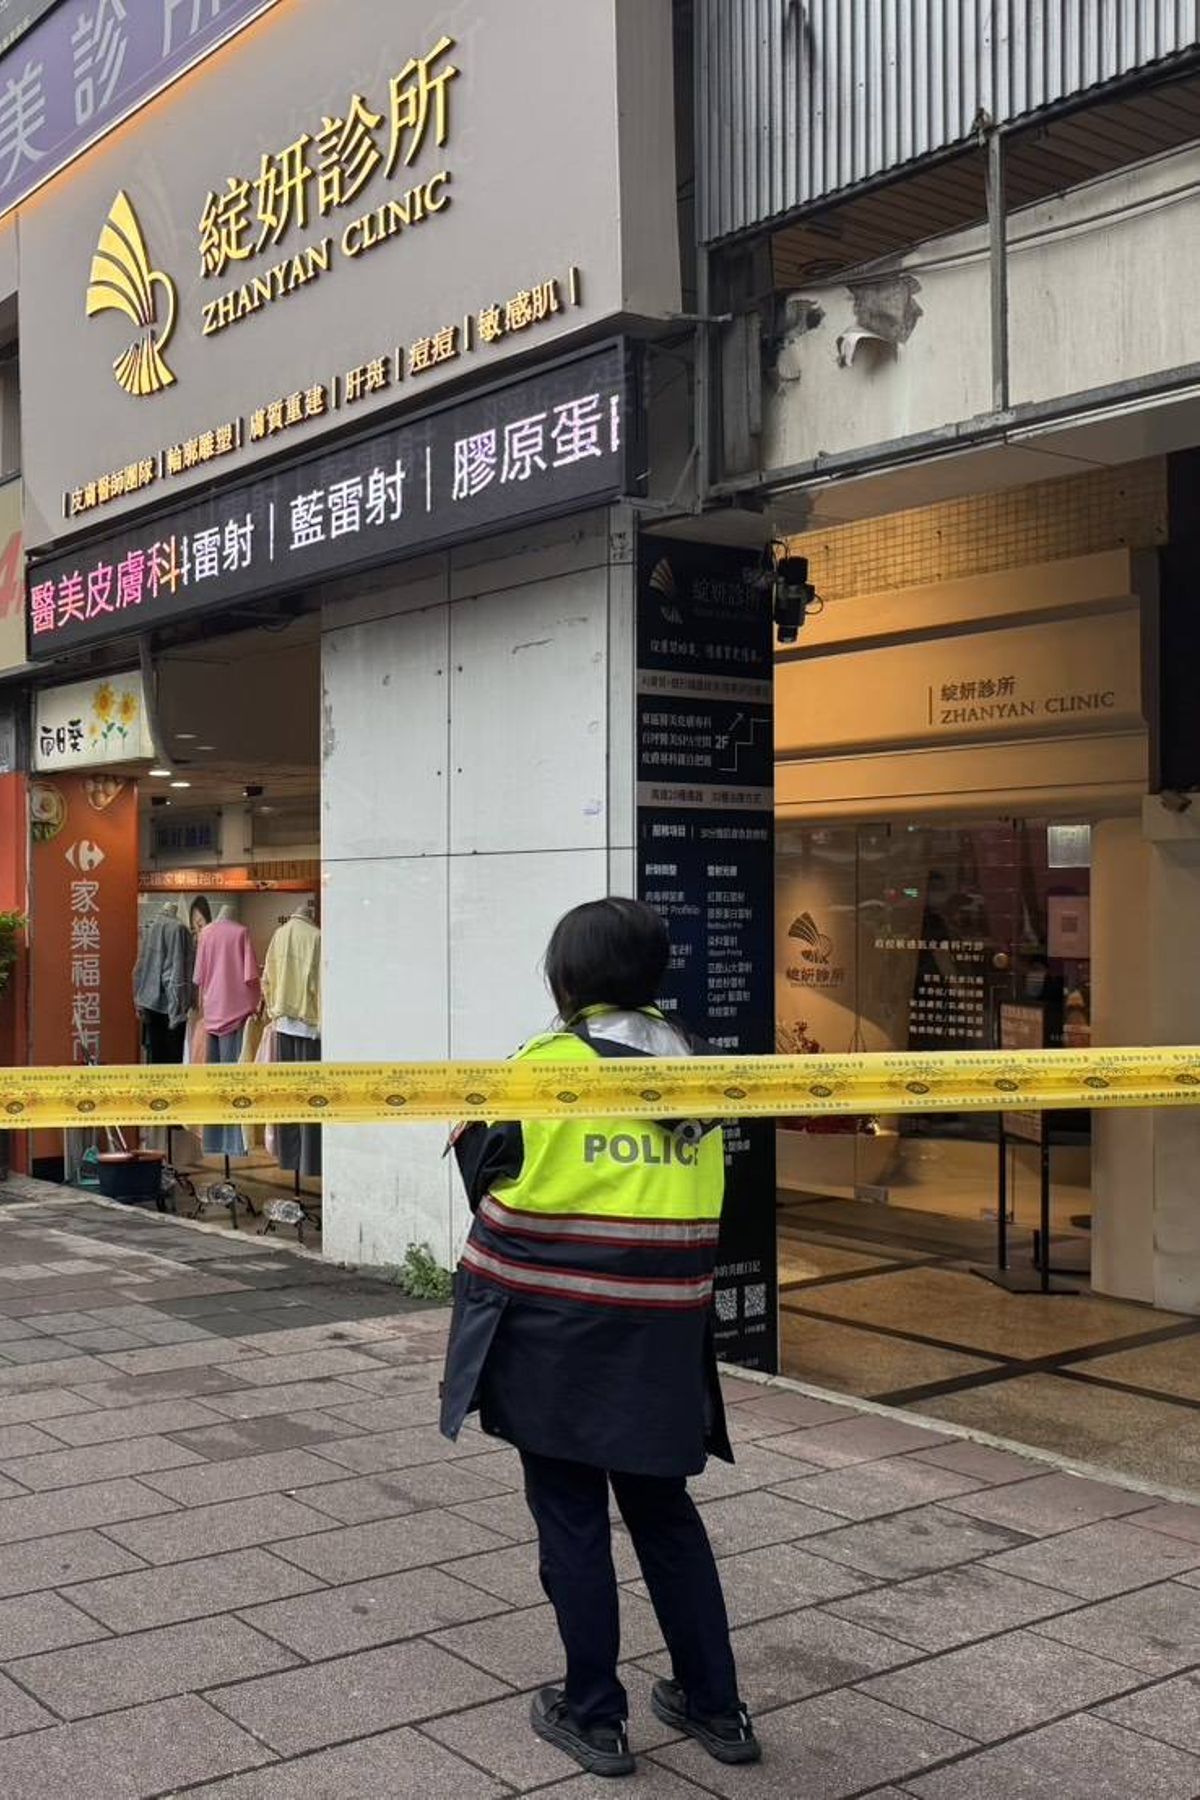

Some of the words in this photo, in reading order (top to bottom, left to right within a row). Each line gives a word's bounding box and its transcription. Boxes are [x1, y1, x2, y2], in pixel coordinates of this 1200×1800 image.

[198, 35, 458, 278] 綻妍診所
[201, 240, 330, 336] ZHANYAN
[341, 171, 452, 258] CLINIC
[344, 356, 387, 403] 肝斑
[406, 325, 459, 374] 痘痘
[476, 277, 561, 343] 敏感肌
[30, 535, 180, 635] 醫美皮膚科
[289, 459, 406, 550] 藍雷射
[451, 392, 621, 516] 膠原蛋
[714, 735, 730, 750] 2F
[939, 675, 1016, 702] 綻妍診所
[940, 700, 1035, 725] ZHANYAN
[1044, 691, 1116, 714] CLINIC
[68, 877, 102, 1067] 家樂福超市
[583, 1132, 699, 1167] POLIC
